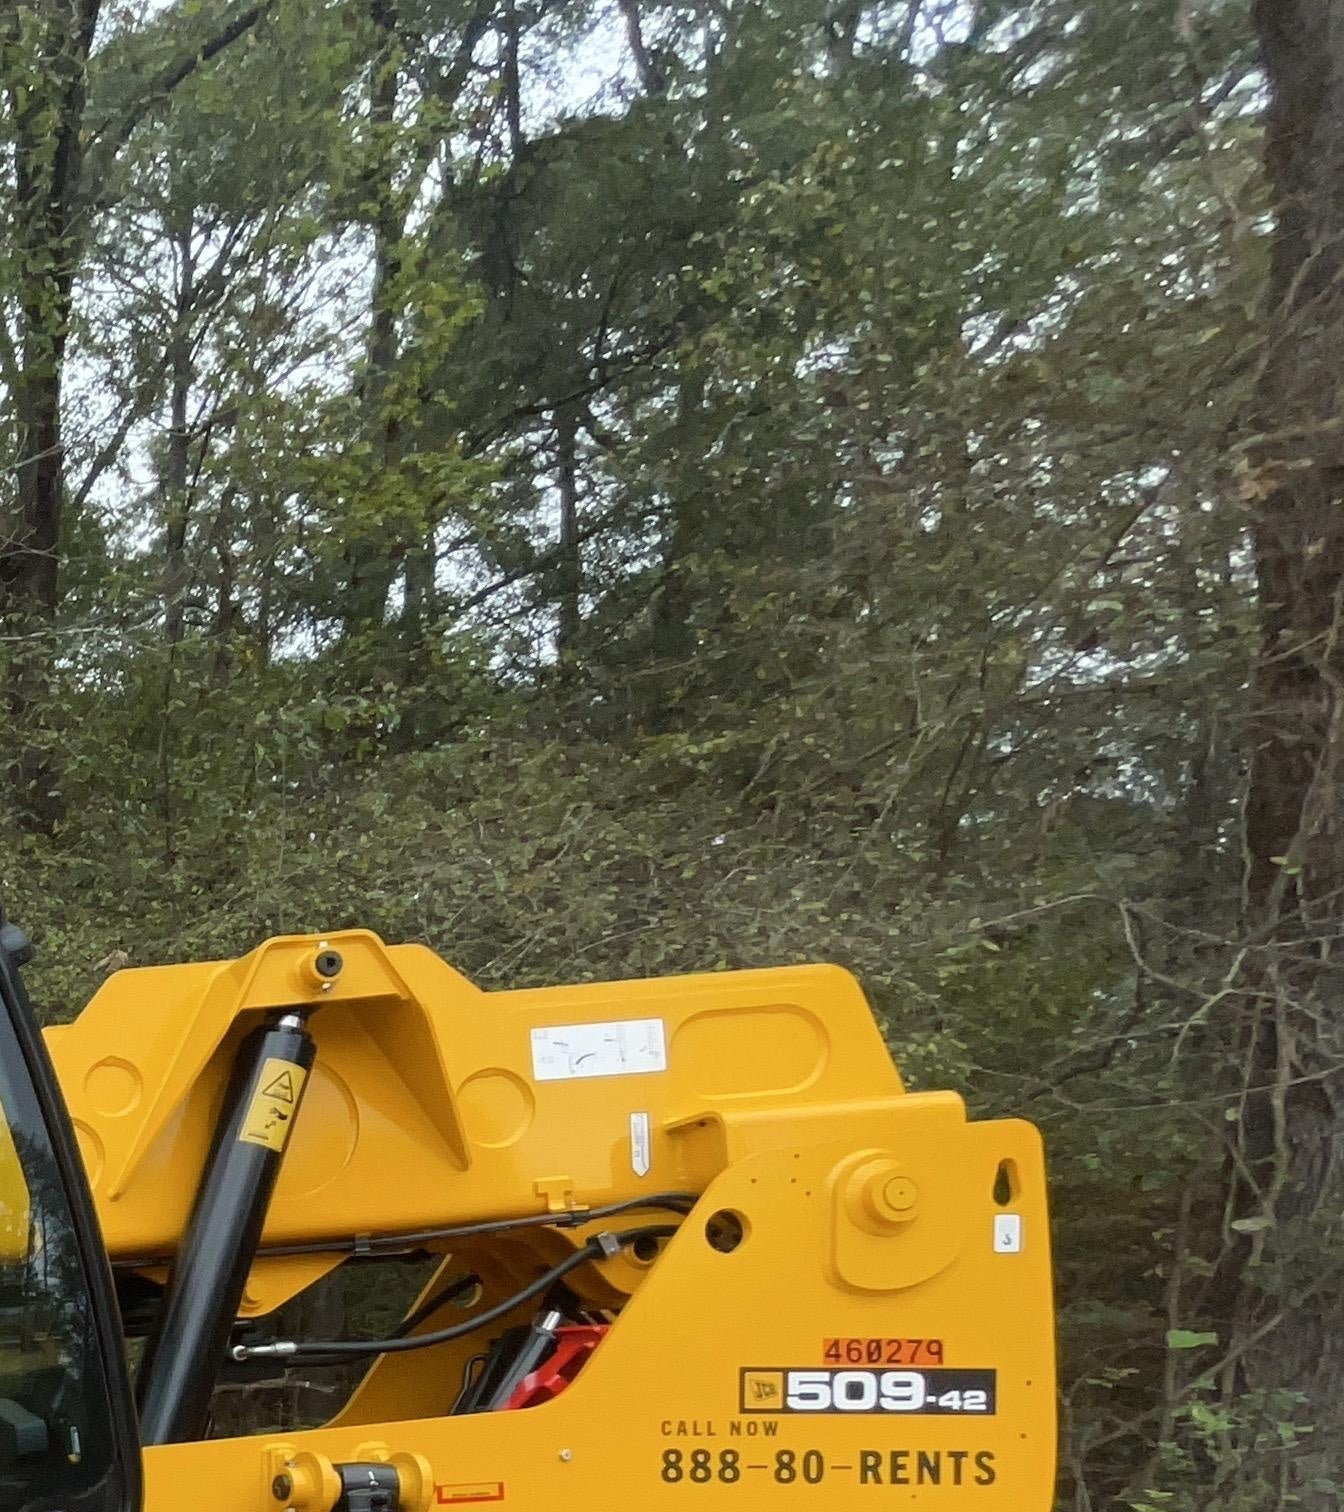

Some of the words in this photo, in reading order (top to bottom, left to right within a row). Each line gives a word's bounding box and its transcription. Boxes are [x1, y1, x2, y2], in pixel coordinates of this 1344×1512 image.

[824, 1338, 944, 1363] 460279
[786, 1370, 988, 1410] 509-42
[661, 1420, 717, 1436] CALL
[730, 1421, 779, 1436] NOW
[661, 1448, 997, 1485] 888-80-RENTS
